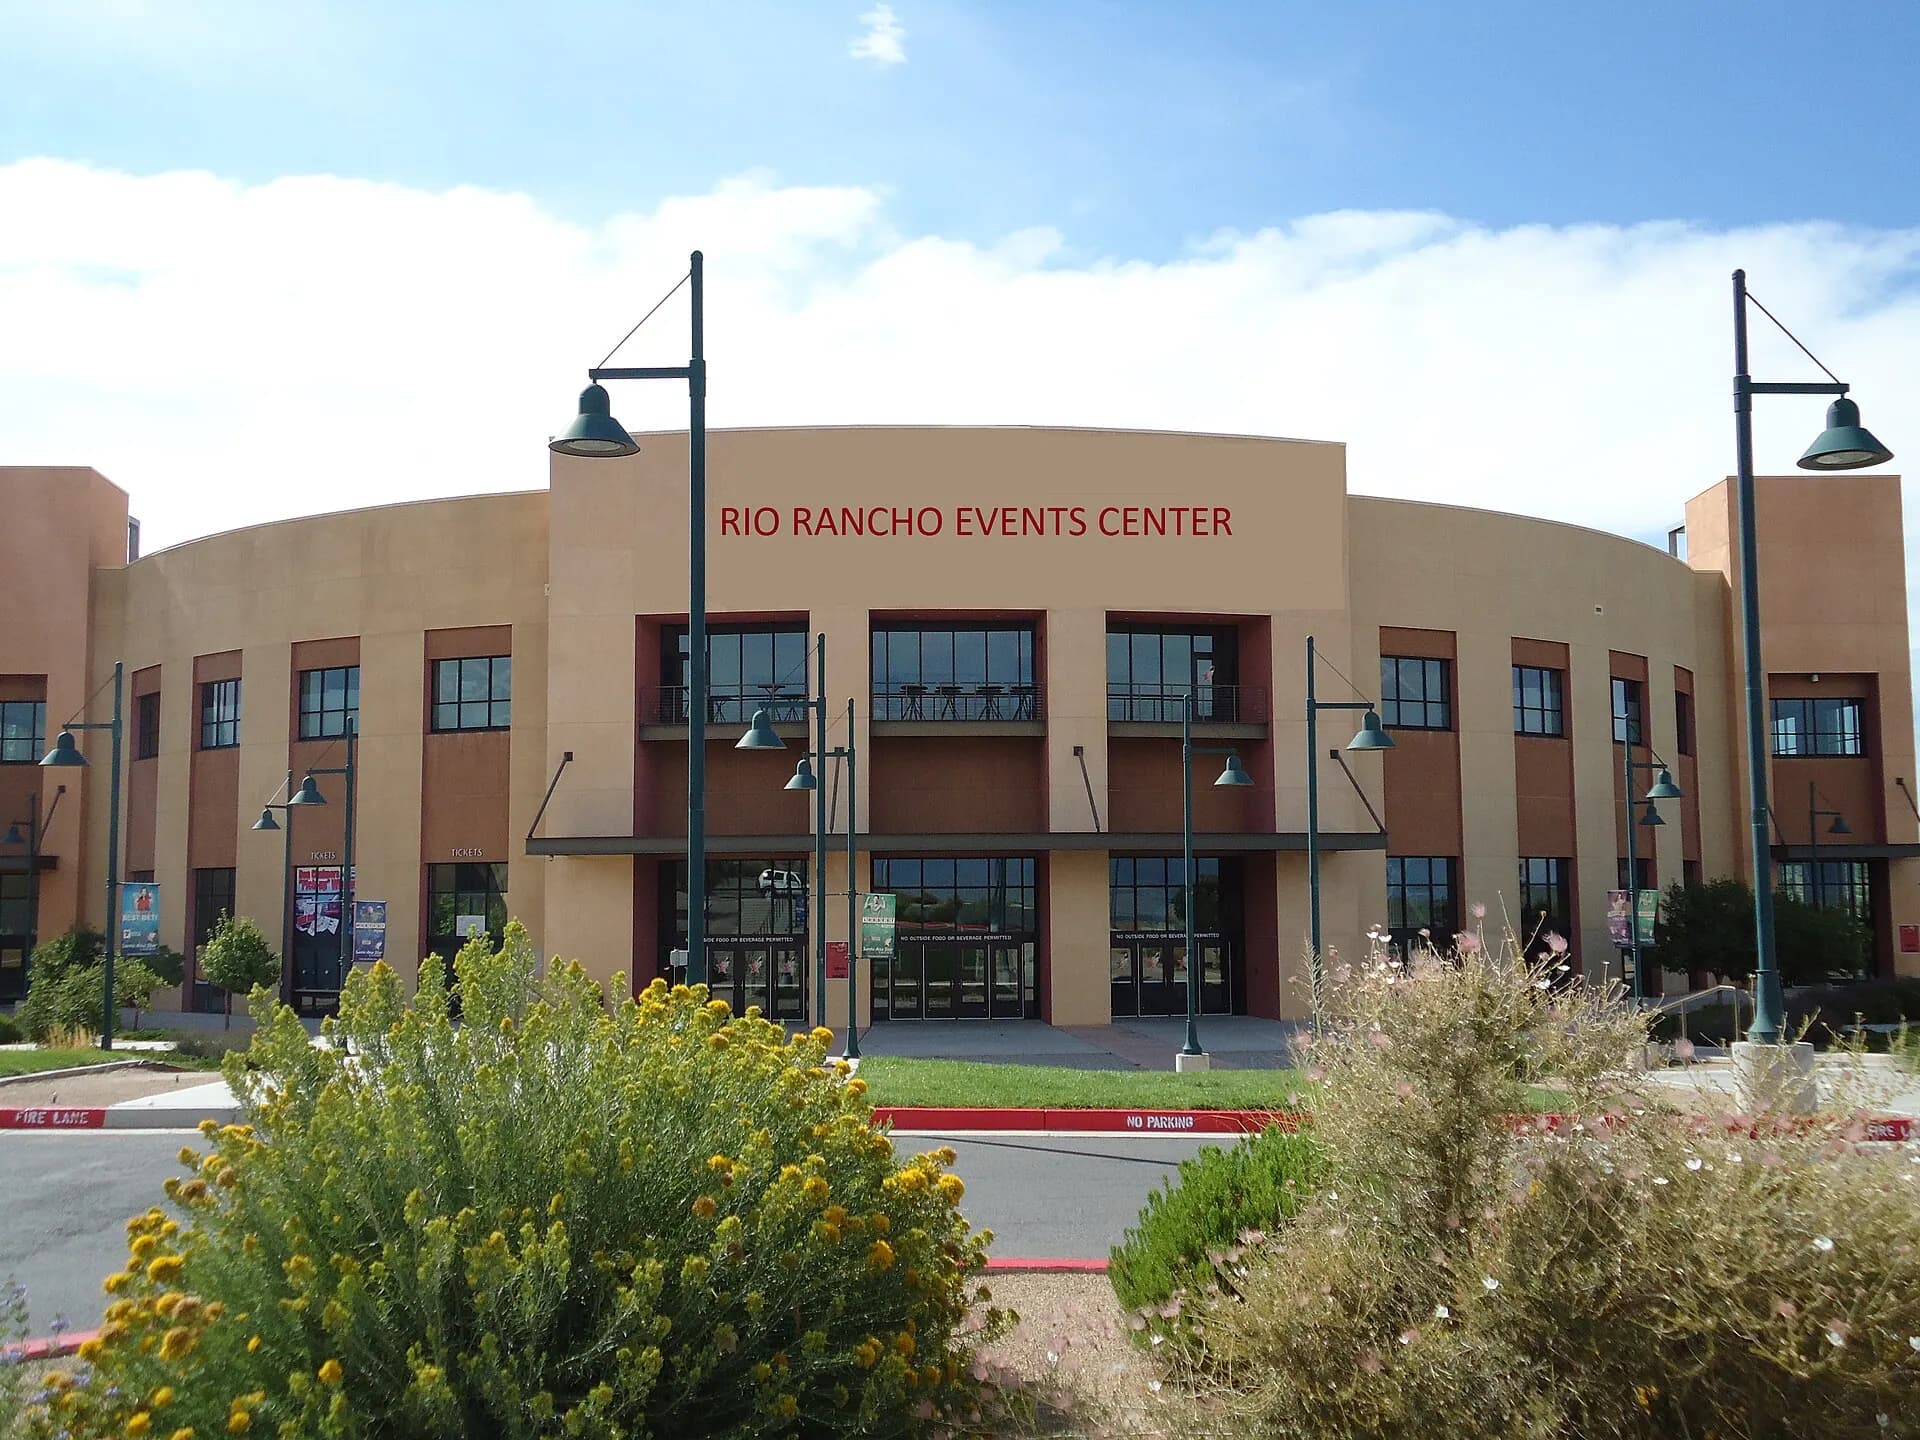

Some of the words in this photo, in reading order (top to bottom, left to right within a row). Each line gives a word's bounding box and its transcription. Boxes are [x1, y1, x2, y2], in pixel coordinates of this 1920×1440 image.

[720, 507, 780, 536] RIO
[793, 507, 943, 536] RANCHO
[956, 507, 1087, 536] EVENTS
[1098, 507, 1233, 536] CENTER
[311, 851, 336, 860] TICKETS
[450, 848, 483, 857] TICKETS
[15, 1110, 47, 1125] FIRE
[52, 1111, 89, 1124] LANE
[1127, 1116, 1143, 1128] NO
[1147, 1116, 1194, 1129] PARKING
[1867, 1124, 1896, 1137] FIRE
